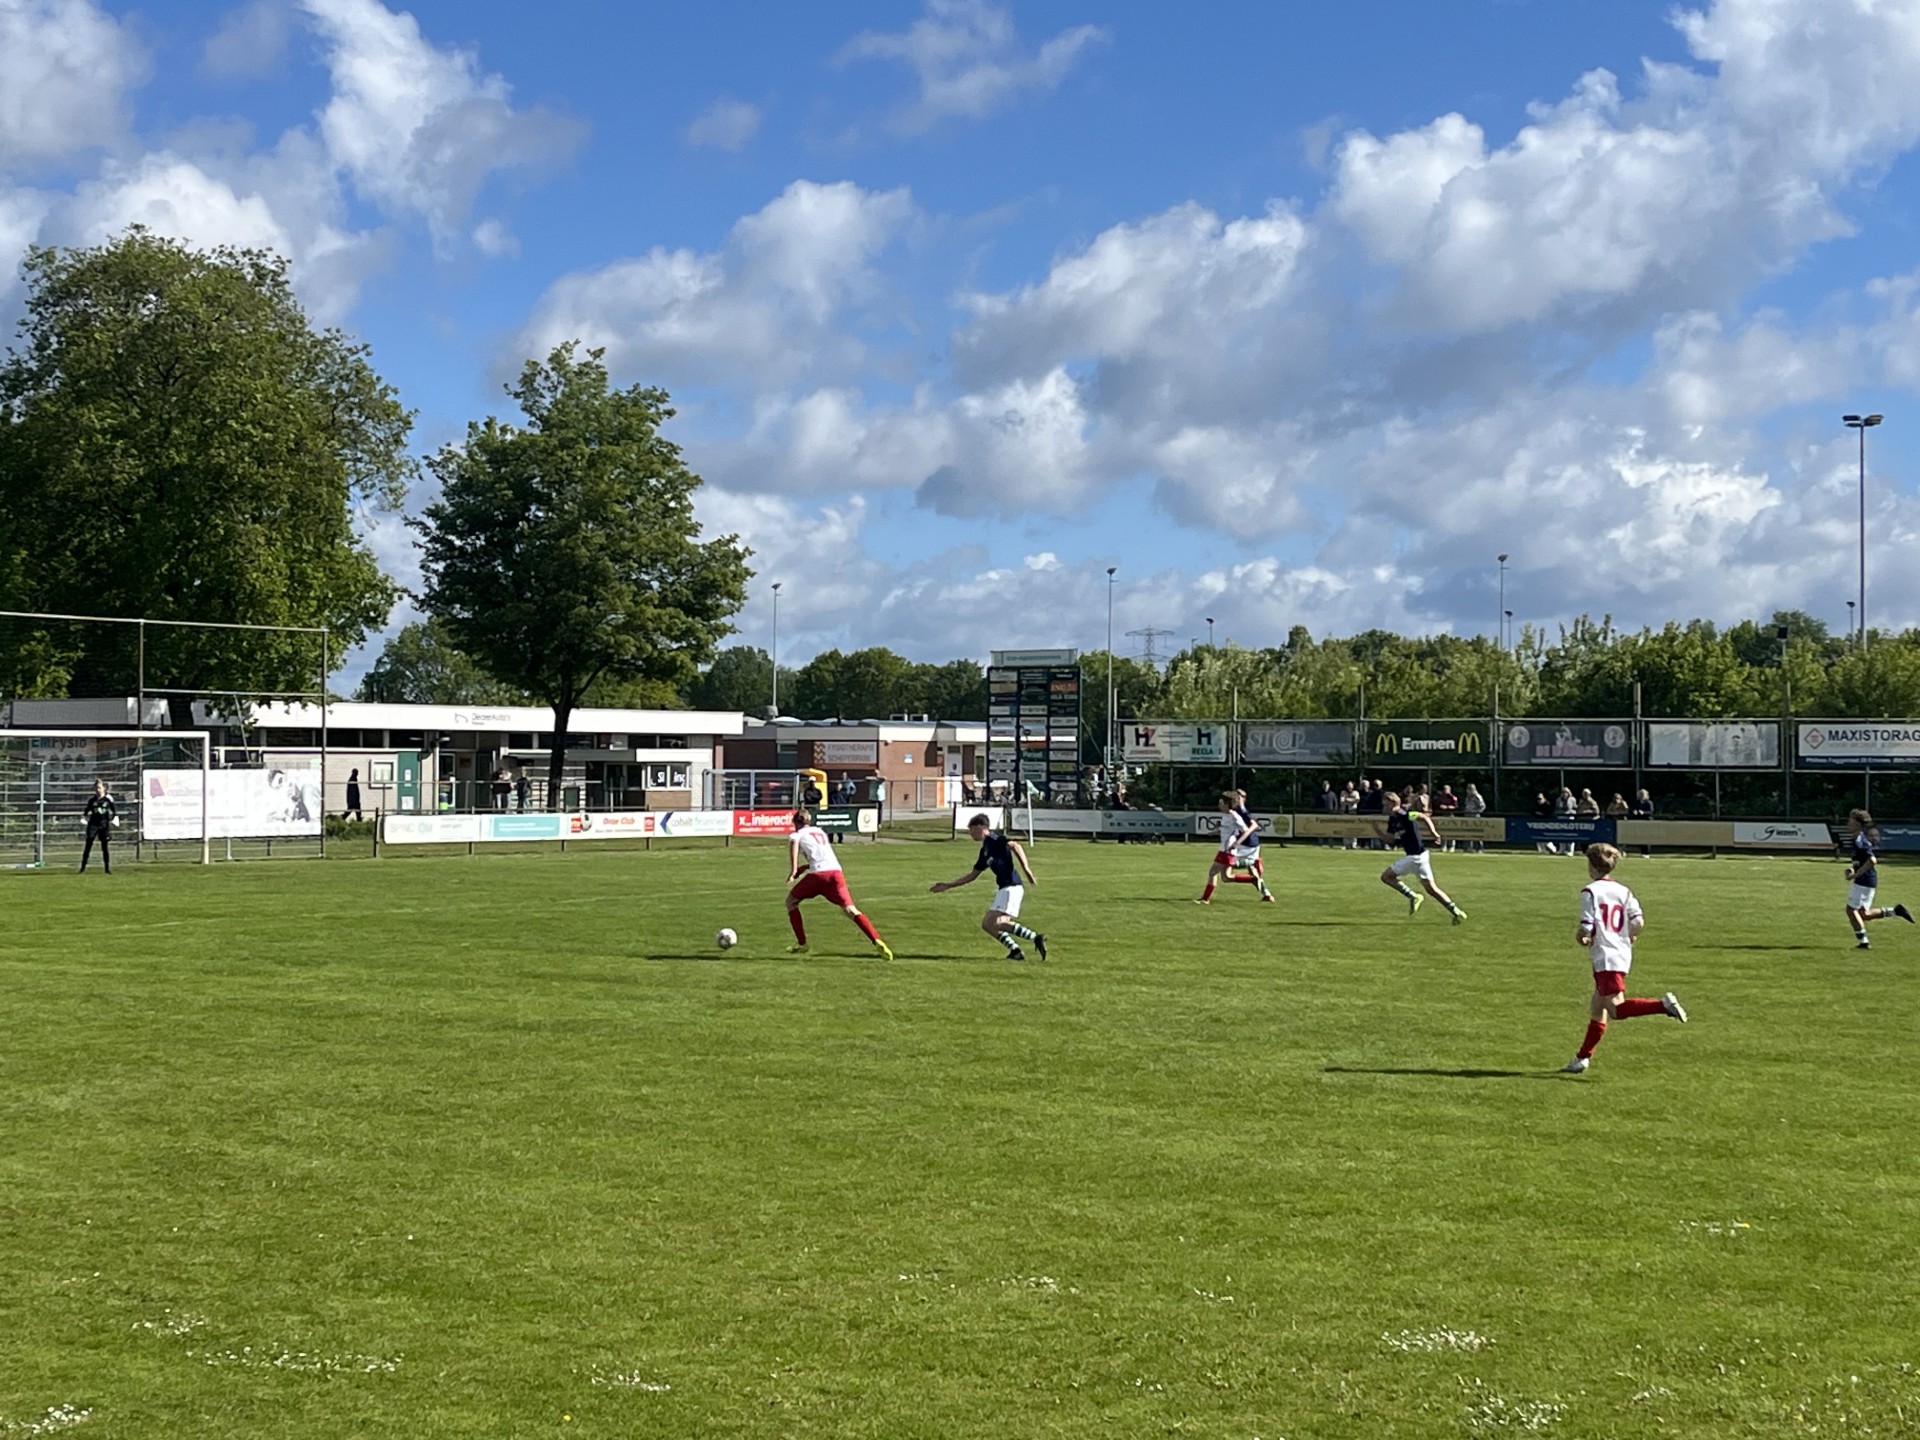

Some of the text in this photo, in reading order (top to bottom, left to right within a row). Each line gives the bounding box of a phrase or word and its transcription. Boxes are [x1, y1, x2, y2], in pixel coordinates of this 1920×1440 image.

[1401, 737, 1456, 751] Emmen
[739, 812, 795, 826] x_interacti
[1598, 902, 1625, 933] 10
